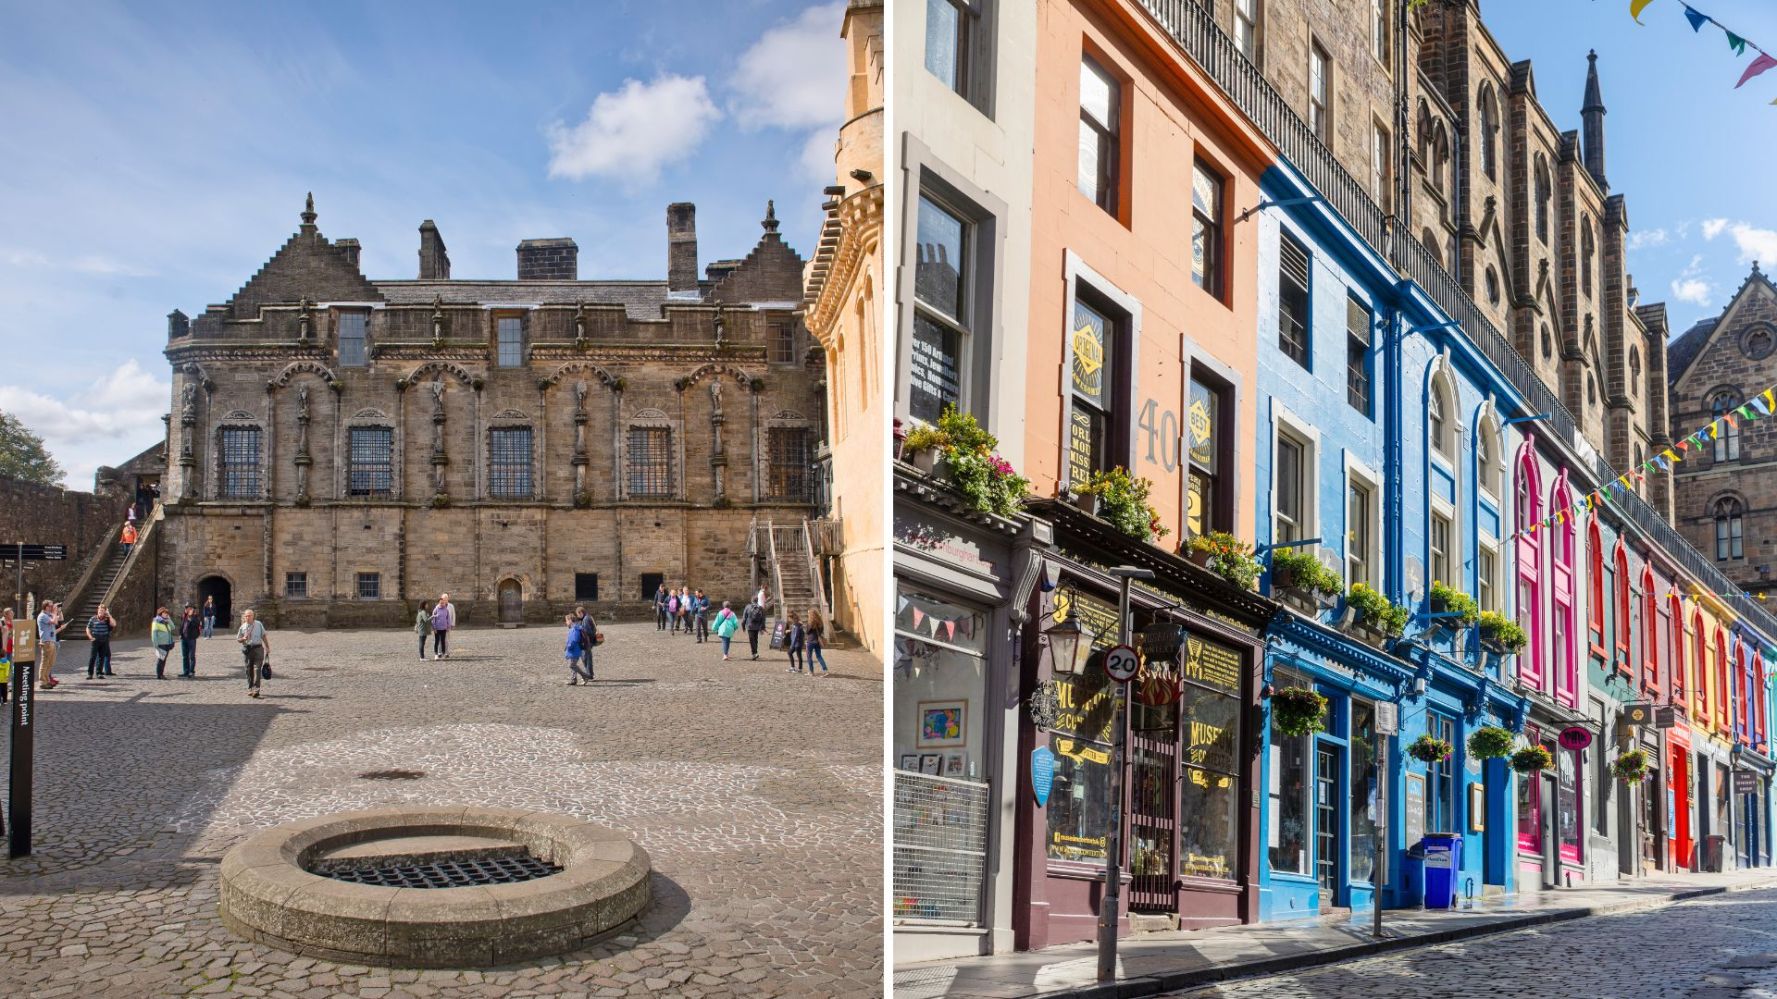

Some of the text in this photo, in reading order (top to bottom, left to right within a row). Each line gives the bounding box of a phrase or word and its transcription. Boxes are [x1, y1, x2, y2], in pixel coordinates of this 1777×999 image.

[921, 340, 931, 355] 150
[1190, 411, 1208, 433] BEST
[1138, 398, 1178, 473] 40
[1110, 655, 1135, 672] 20
[20, 666, 30, 702] Meeting
[19, 703, 30, 726] point
